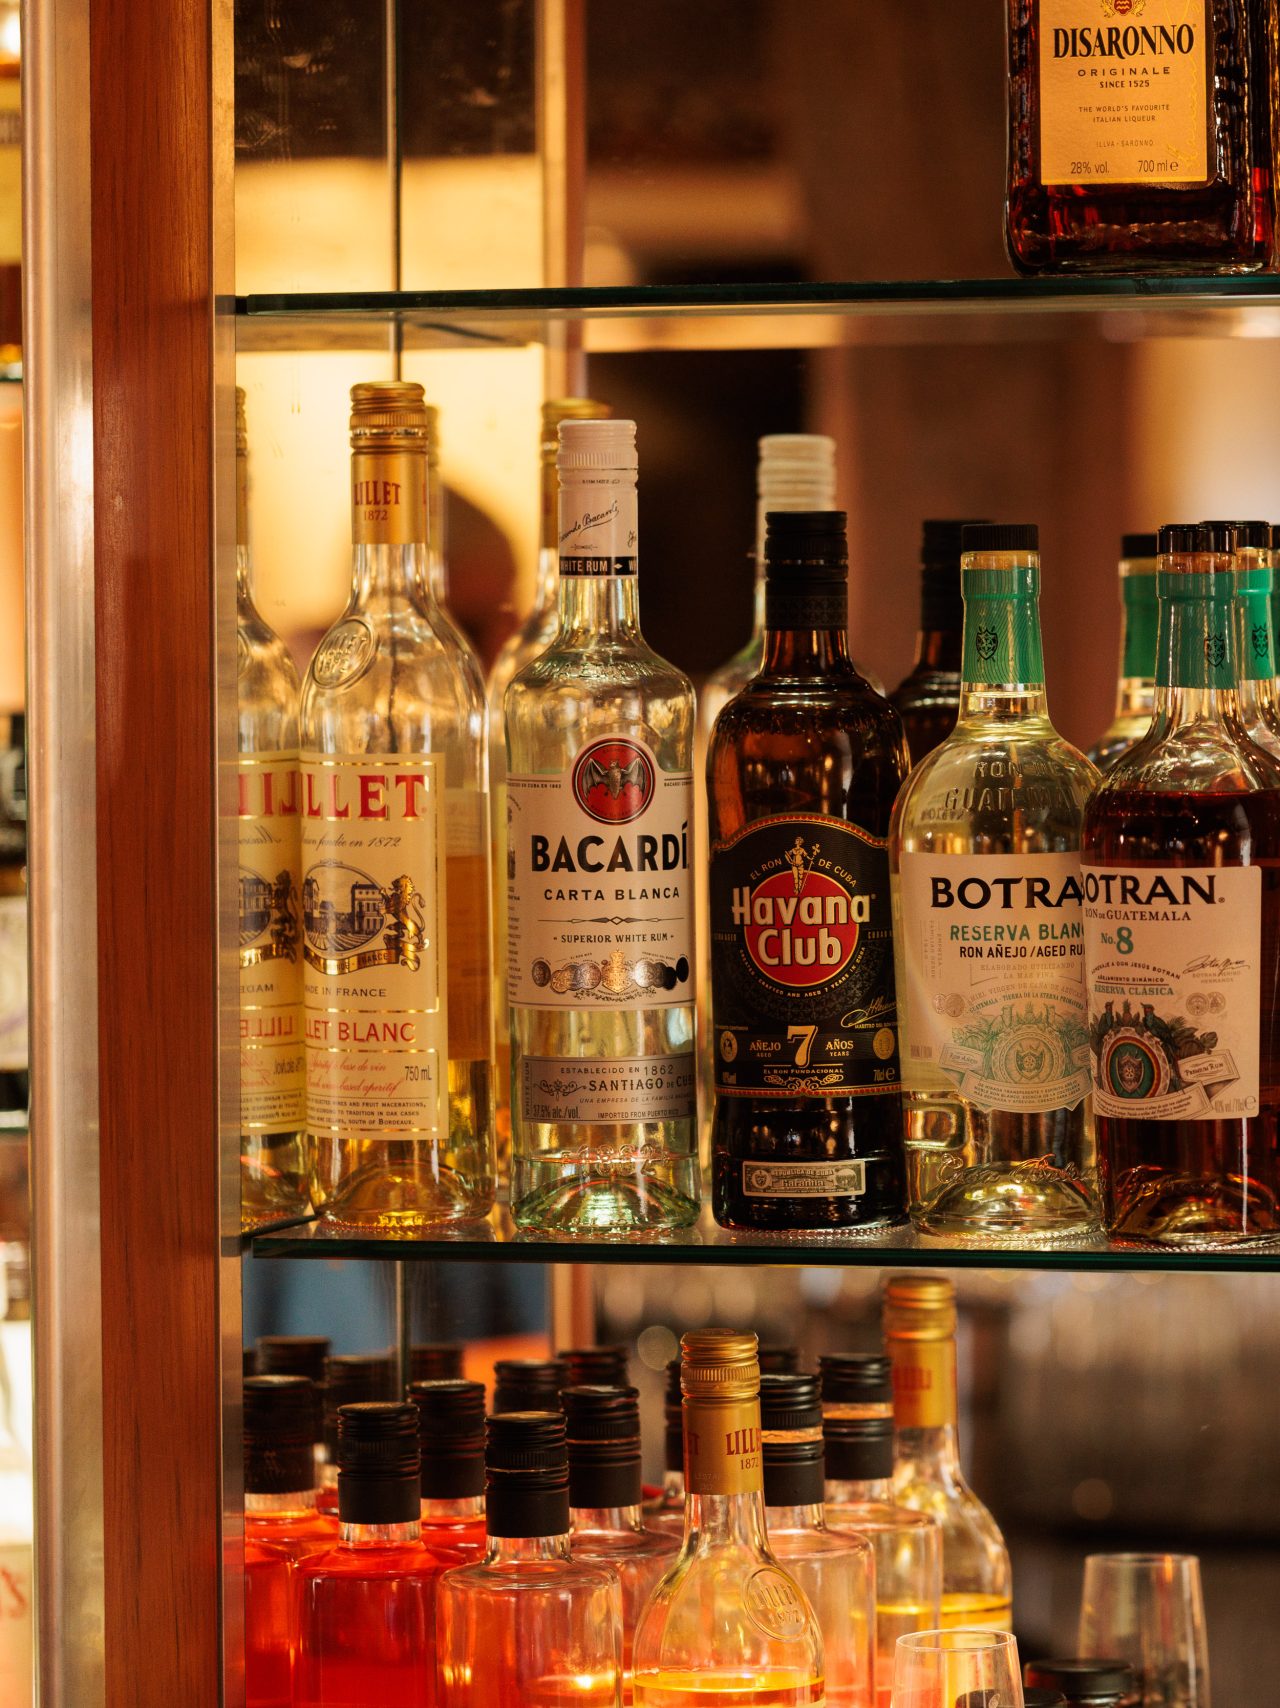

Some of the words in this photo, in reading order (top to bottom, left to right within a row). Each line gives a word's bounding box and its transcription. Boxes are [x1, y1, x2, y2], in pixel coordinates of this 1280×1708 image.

[1053, 23, 1195, 60] DISARONNO
[1077, 66, 1171, 77] ORIGINALE
[1099, 80, 1125, 89] SINCE
[1129, 79, 1151, 88] 1525
[1131, 104, 1170, 112] FAVOURITE
[1124, 115, 1156, 123] LIQUEUR
[1070, 161, 1092, 174] 28%
[1095, 161, 1110, 174] vol.
[1137, 160, 1155, 173] 700
[1156, 159, 1168, 172] ml
[364, 509, 388, 521] 1872
[586, 560, 608, 572] RUM
[306, 773, 426, 819] LLET
[367, 836, 402, 848] 1872
[531, 819, 689, 873] BACARDÍ
[750, 870, 762, 881] EL
[761, 858, 783, 872] RON
[817, 858, 833, 871] DE
[833, 865, 857, 888] CUBA
[544, 889, 605, 901] CARTA
[615, 887, 680, 900] BLANCA
[930, 875, 1083, 910] BOTRA
[731, 886, 871, 926] Havana
[1106, 910, 1192, 922] GUATEMALA
[561, 934, 612, 944] SUPERIOR
[615, 933, 648, 943] WHITE
[650, 932, 669, 942] RUM
[950, 923, 1031, 942] RESERVA
[1038, 922, 1084, 940] BLAN
[757, 927, 842, 967] Club
[959, 945, 983, 958] RON
[986, 943, 1027, 958] AÑEJO
[1069, 944, 1085, 956] RU
[1152, 966, 1181, 980] BOTRAN
[336, 987, 387, 998] FRANCE
[804, 989, 822, 998] AGED
[831, 973, 850, 989] YEARS
[1094, 984, 1126, 996] RESERVA
[1128, 983, 1174, 996] CLÁSICA
[969, 998, 999, 1014] GUATEMALA
[1002, 992, 1023, 1002] TIERRA
[305, 1019, 331, 1041] LLET
[338, 1022, 416, 1043] BLANC
[750, 1038, 782, 1051] AÑEJO
[786, 1025, 819, 1069] 7
[825, 1038, 854, 1051] AÑOS
[829, 1050, 850, 1058] YEARS
[404, 1065, 420, 1081] 750
[421, 1065, 432, 1081] mL
[643, 1064, 674, 1077] 1862
[790, 1067, 845, 1075] FUNDACIONAL
[588, 1077, 664, 1092] SANTIAGO
[666, 1081, 675, 1089] DE
[596, 1096, 628, 1104] EMPRESA
[597, 1111, 629, 1119] IMPORTED
[630, 1110, 646, 1118] FROM
[647, 1109, 668, 1118] PUERTO
